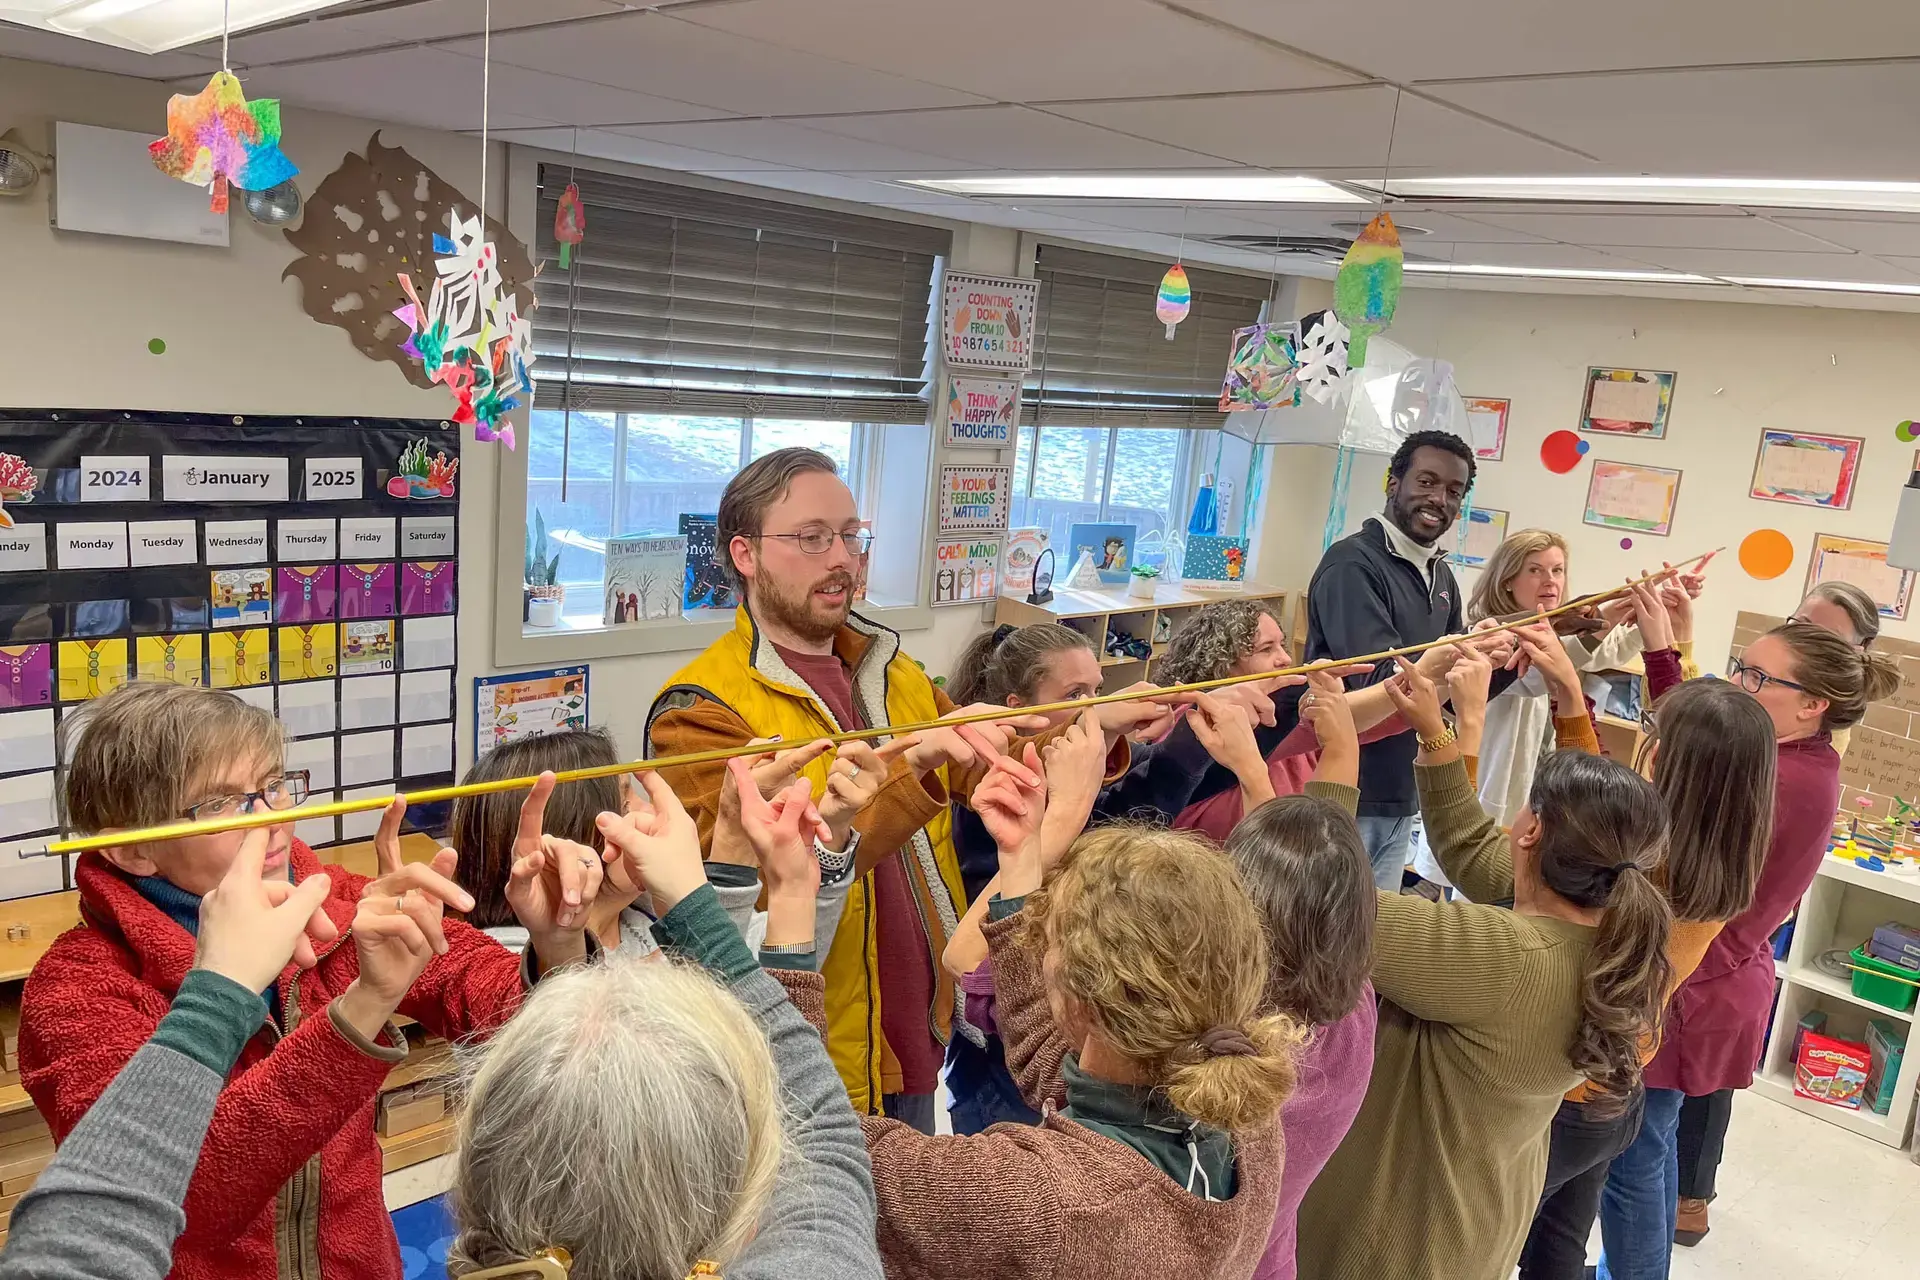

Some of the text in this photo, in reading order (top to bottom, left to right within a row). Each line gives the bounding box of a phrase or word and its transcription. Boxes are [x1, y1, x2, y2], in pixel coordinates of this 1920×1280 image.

[968, 293, 1013, 308] COUNTING
[976, 308, 1003, 321] DOWN
[970, 322, 1005, 336] FROM 10
[952, 336, 961, 349] 10
[967, 393, 998, 408] THINK
[965, 409, 997, 423] HAPPY
[952, 423, 1006, 439] THOUGHTS
[88, 470, 142, 486] 2024
[200, 470, 270, 488] January
[312, 470, 355, 486] 2025
[962, 478, 986, 491] YOUR
[950, 492, 996, 504] FEELINGS
[953, 505, 990, 518] MATTER
[209, 536, 264, 548] Wednesday
[285, 535, 327, 545] Thursday
[355, 533, 382, 543] Friday
[409, 531, 446, 541] Saturday
[0, 541, 30, 552] nday
[69, 539, 114, 552] Monday
[142, 537, 184, 549] Tuesday
[611, 539, 685, 556] TEN WAYS TO HEAR SNOW
[686, 545, 717, 555] now
[938, 543, 998, 560] CALM MIND
[325, 607, 333, 617] 2
[384, 603, 392, 614] 3
[262, 610, 268, 621] 1
[326, 663, 334, 673] 9
[379, 660, 392, 670] 10
[191, 677, 199, 687] 7
[260, 670, 267, 681] 8
[40, 690, 48, 700] 5
[1859, 731, 1874, 745] look
[1880, 737, 1904, 752] before
[1844, 763, 1859, 774] and
[1864, 766, 1875, 778] the
[1879, 772, 1900, 785] plant
